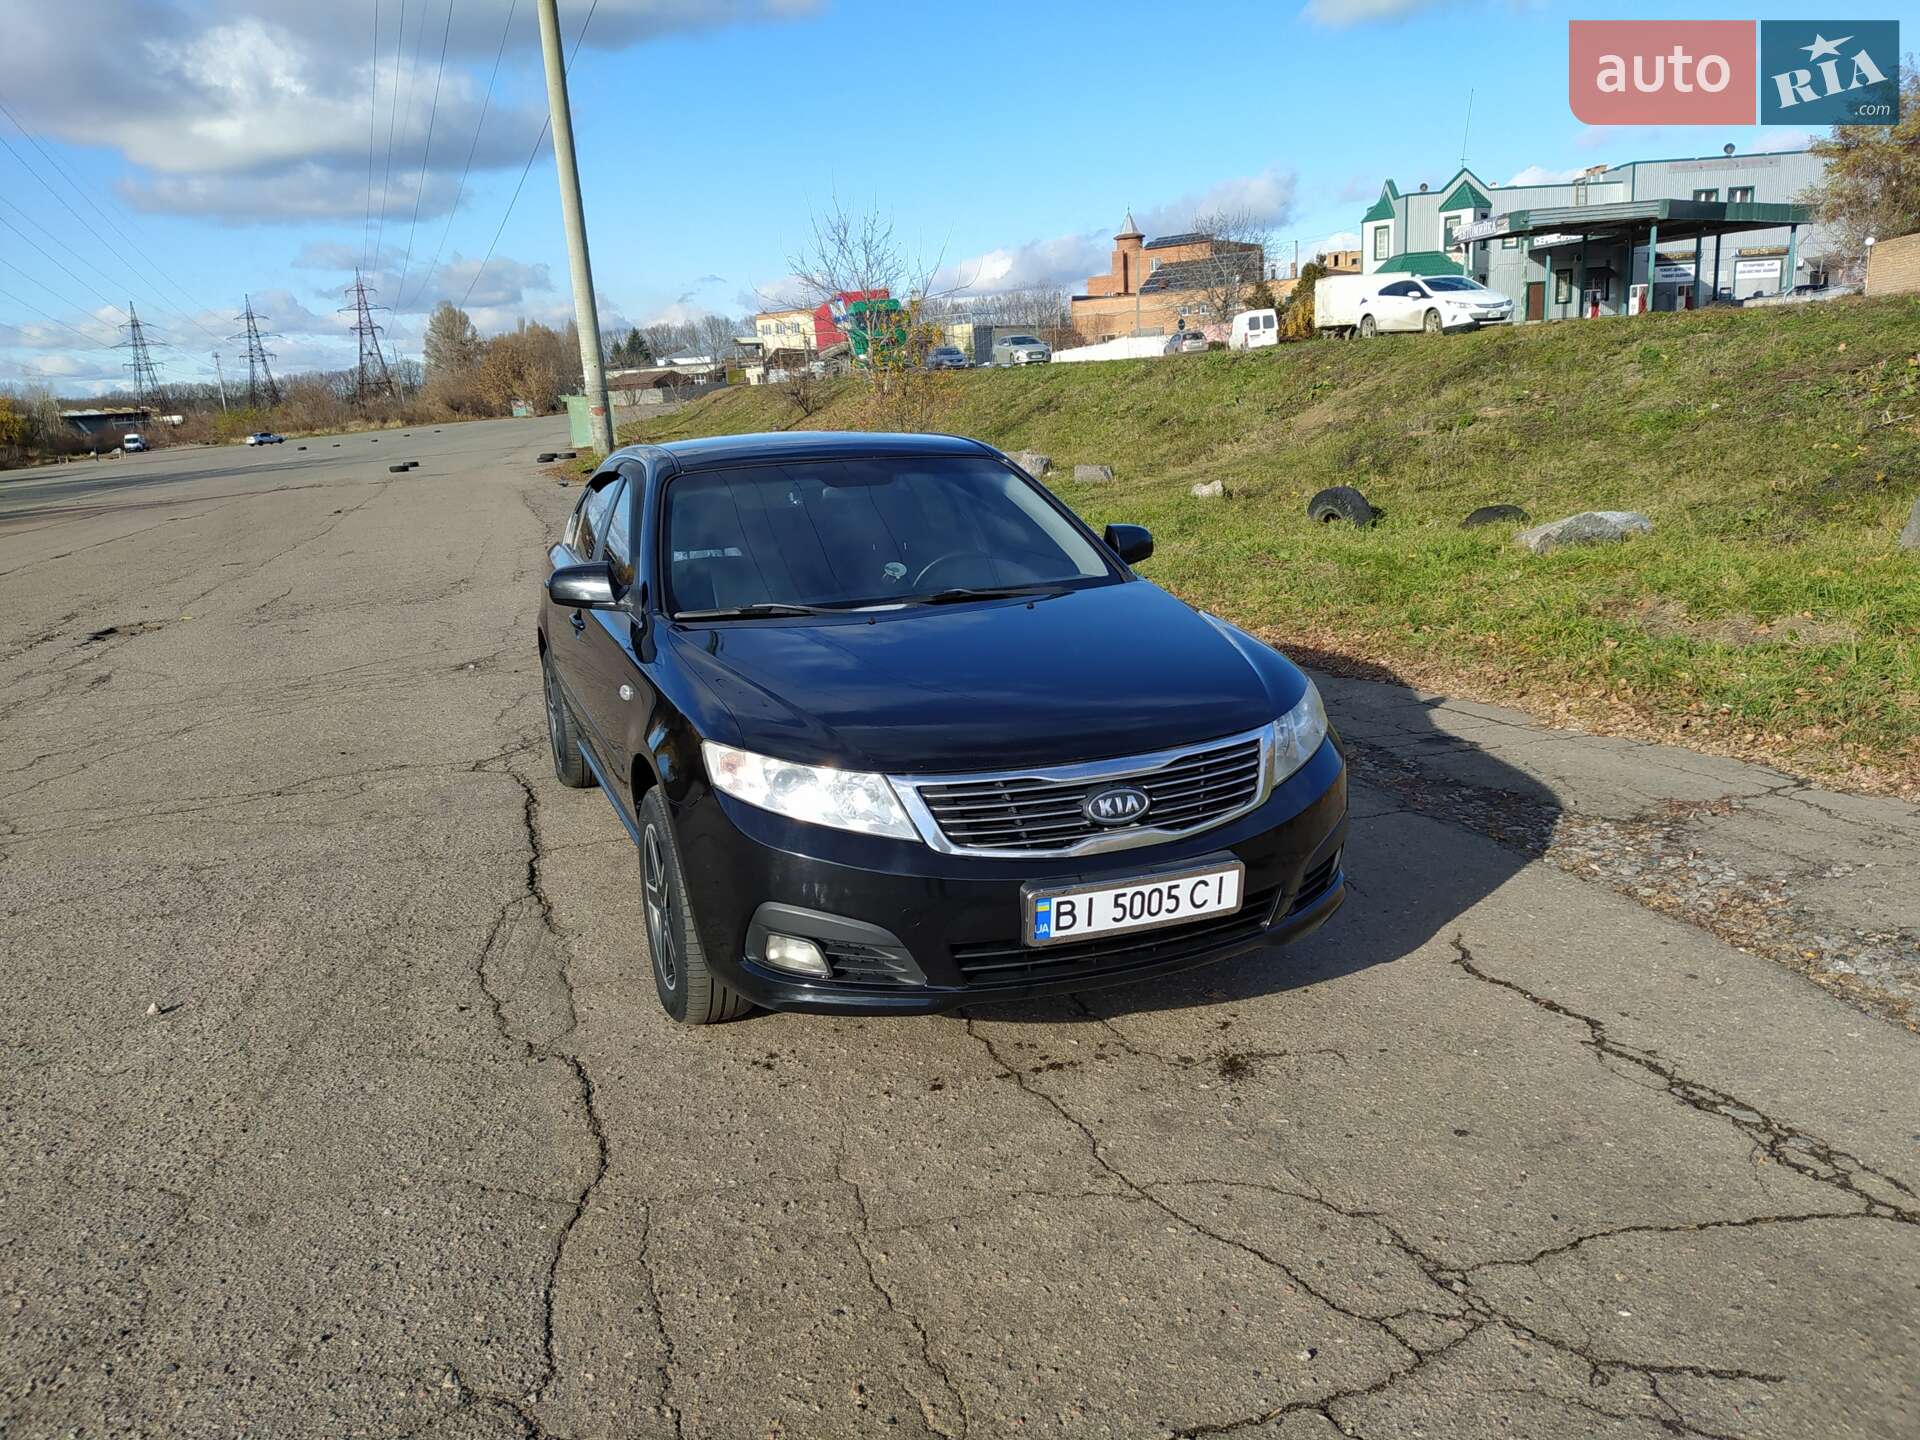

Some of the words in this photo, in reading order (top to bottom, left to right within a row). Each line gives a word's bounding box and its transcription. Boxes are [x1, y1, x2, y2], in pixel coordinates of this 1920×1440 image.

[1098, 794, 1140, 817] KIA
[1055, 897, 1094, 931] BI
[1112, 884, 1181, 923] 5005
[1189, 876, 1224, 910] CI
[1035, 923, 1050, 934] UA
